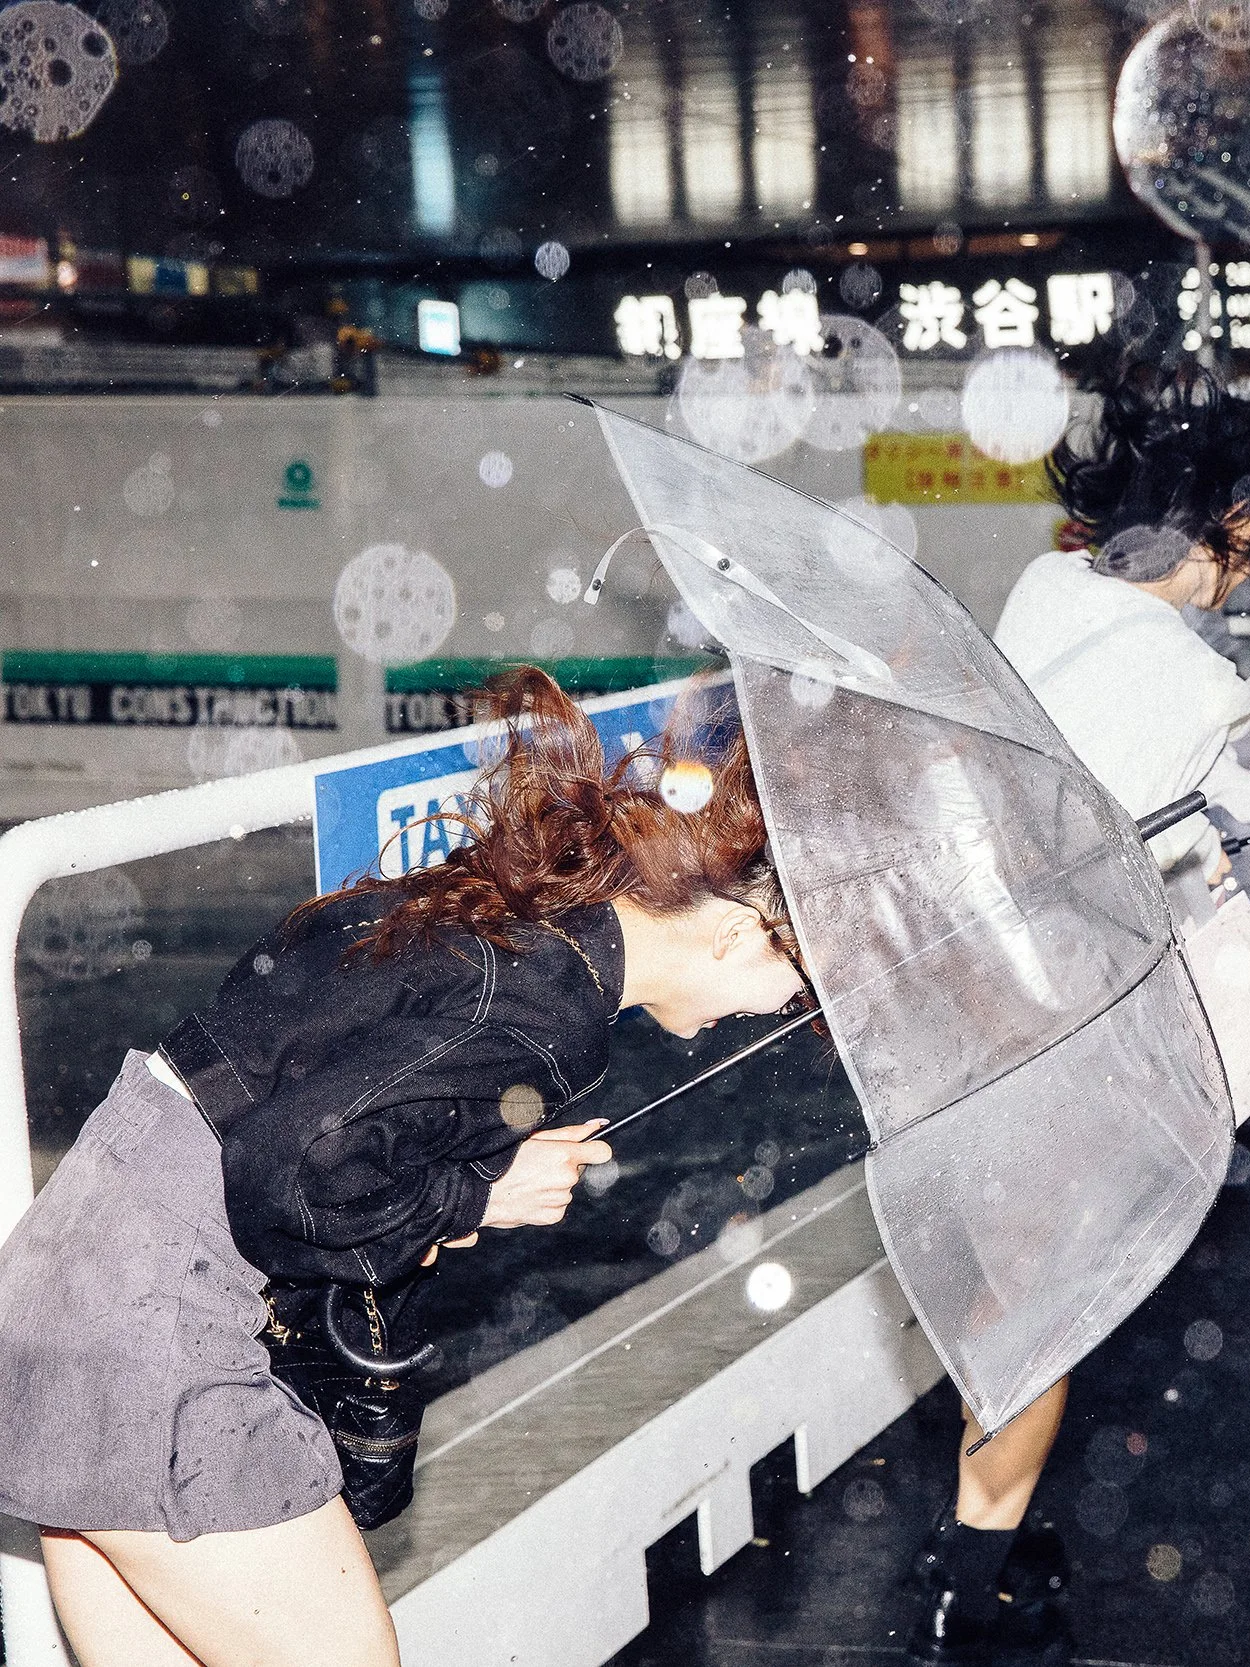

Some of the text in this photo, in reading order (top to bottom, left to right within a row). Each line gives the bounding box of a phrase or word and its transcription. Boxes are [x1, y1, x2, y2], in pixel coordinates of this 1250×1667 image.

[899, 272, 1117, 350] 渋谷駅
[391, 793, 486, 874] TAX
